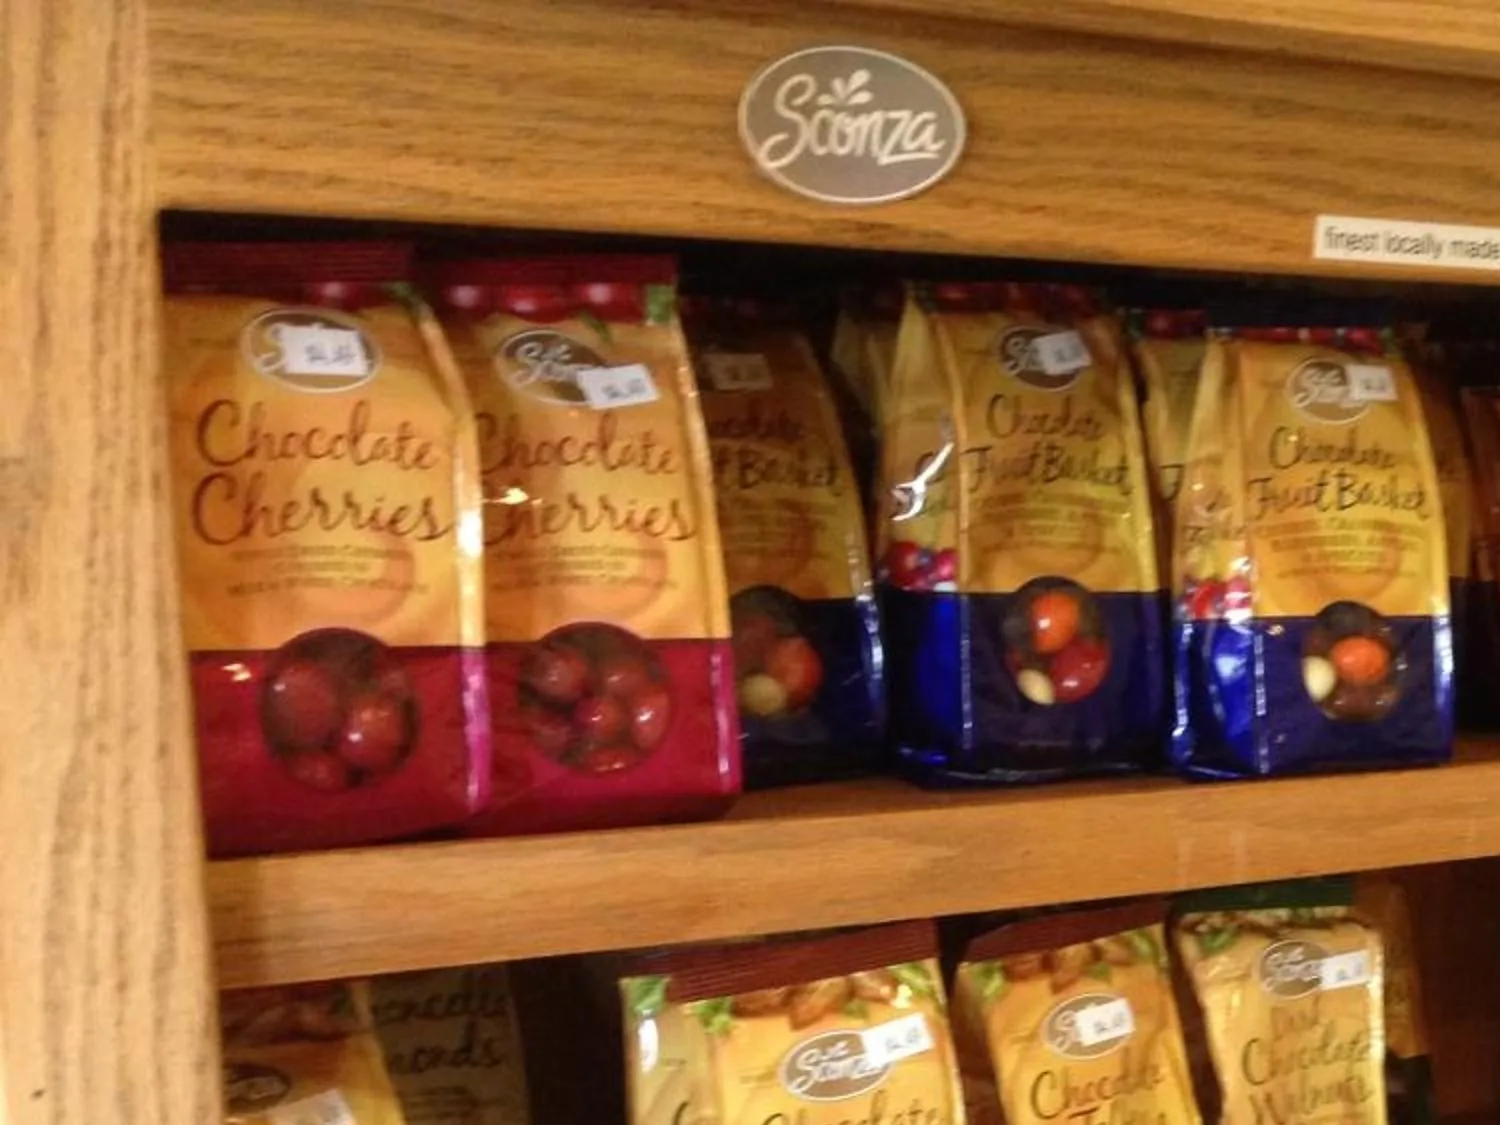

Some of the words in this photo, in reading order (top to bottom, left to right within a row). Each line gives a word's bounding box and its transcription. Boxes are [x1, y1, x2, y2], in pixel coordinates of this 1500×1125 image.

[760, 73, 946, 169] Sconza
[1384, 231, 1443, 259] locally
[1450, 238, 1500, 260] made
[195, 399, 442, 471] Chocolate
[192, 471, 456, 546] Cherries
